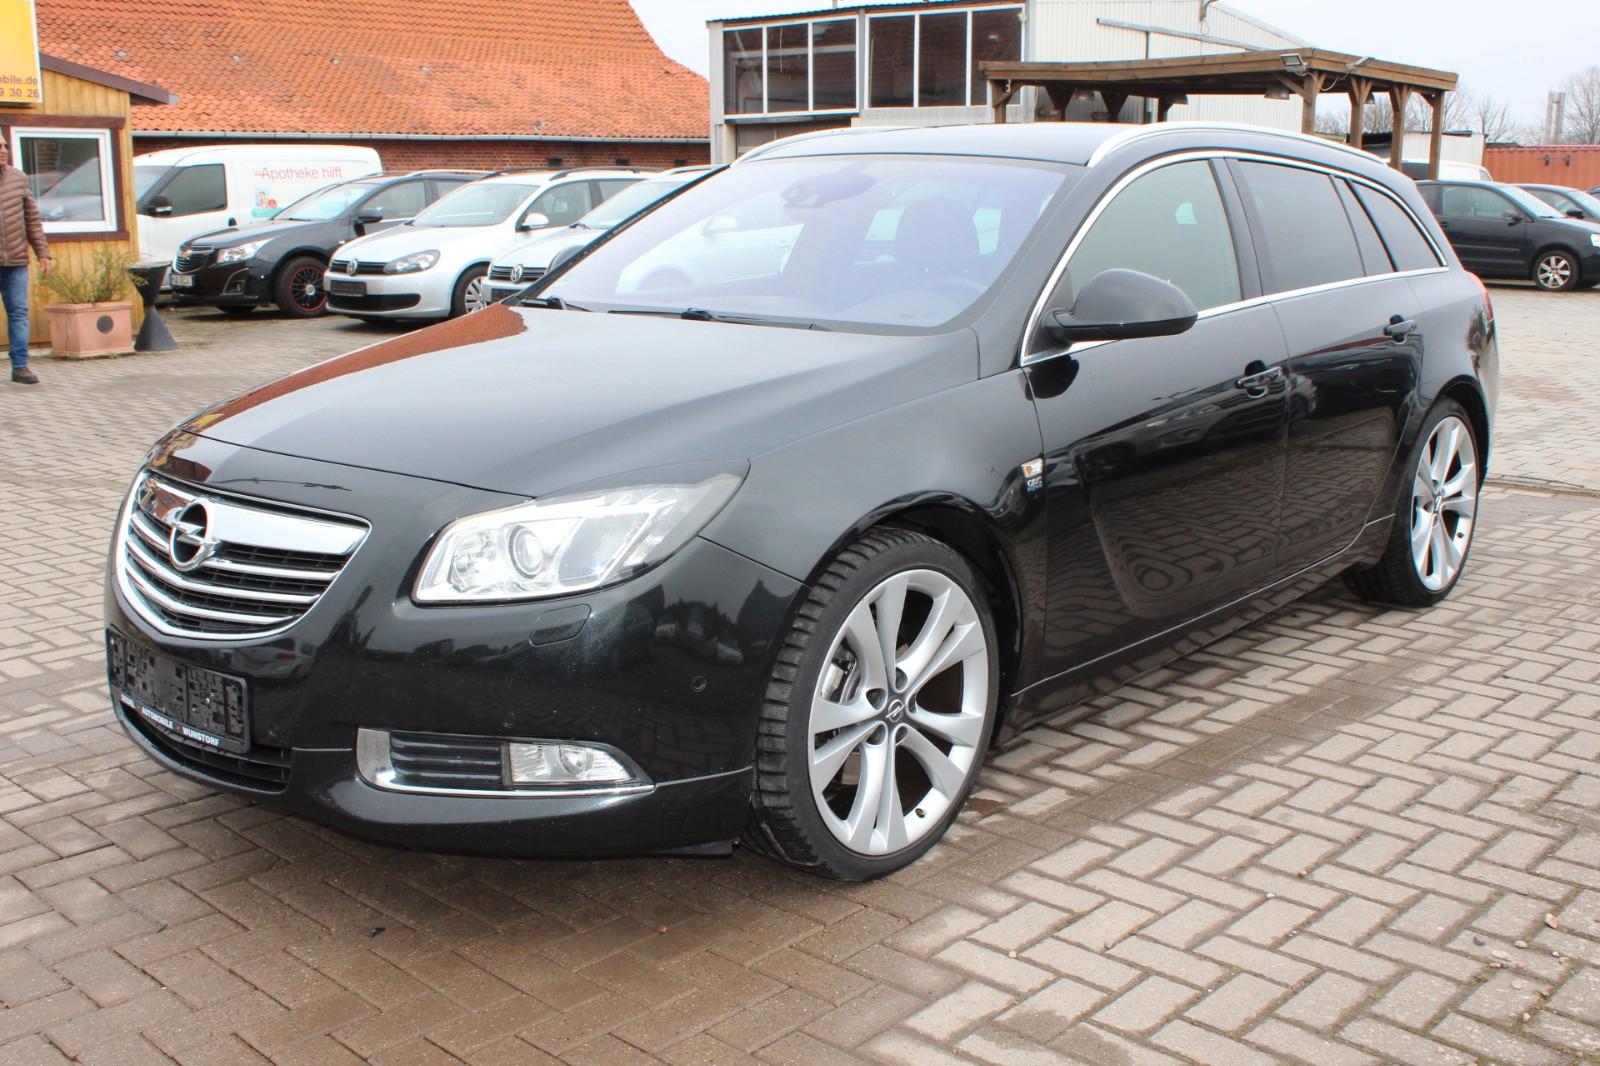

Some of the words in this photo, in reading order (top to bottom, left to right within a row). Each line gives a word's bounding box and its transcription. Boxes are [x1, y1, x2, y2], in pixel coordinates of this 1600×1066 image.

[10, 88, 22, 98] 30
[27, 88, 40, 99] 26
[258, 167, 319, 181] Apotheke
[322, 166, 343, 179] hilft
